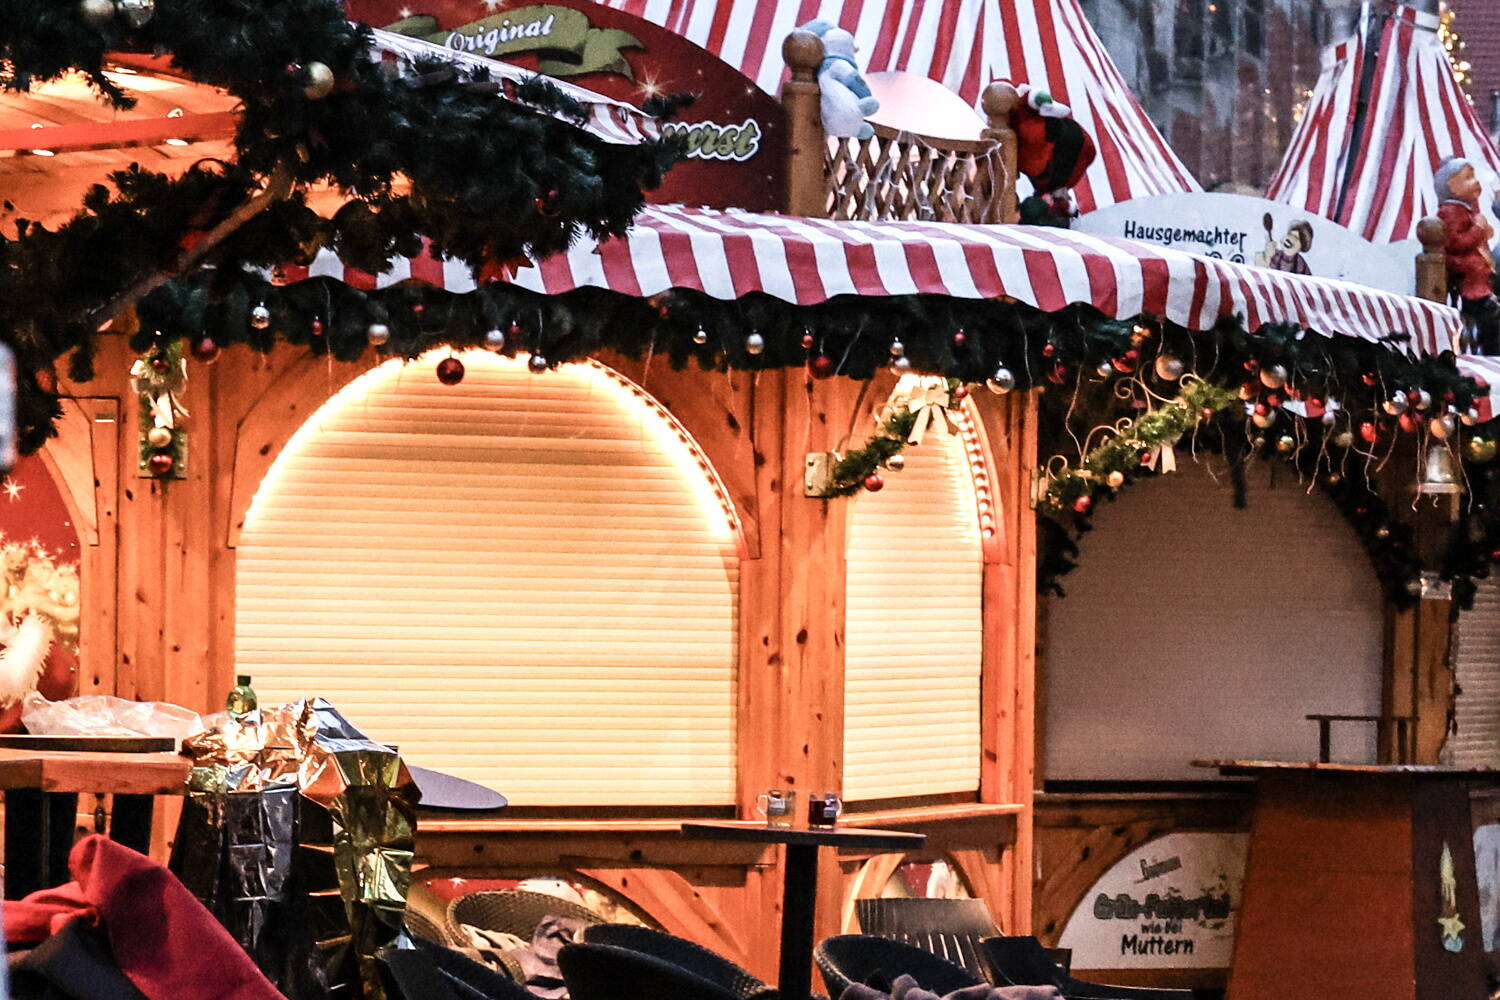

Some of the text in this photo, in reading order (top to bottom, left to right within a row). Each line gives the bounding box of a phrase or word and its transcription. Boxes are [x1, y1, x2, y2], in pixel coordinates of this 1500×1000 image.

[445, 14, 554, 55] Original
[1124, 220, 1247, 253] Hausgemachter
[1121, 934, 1194, 955] Muttern
